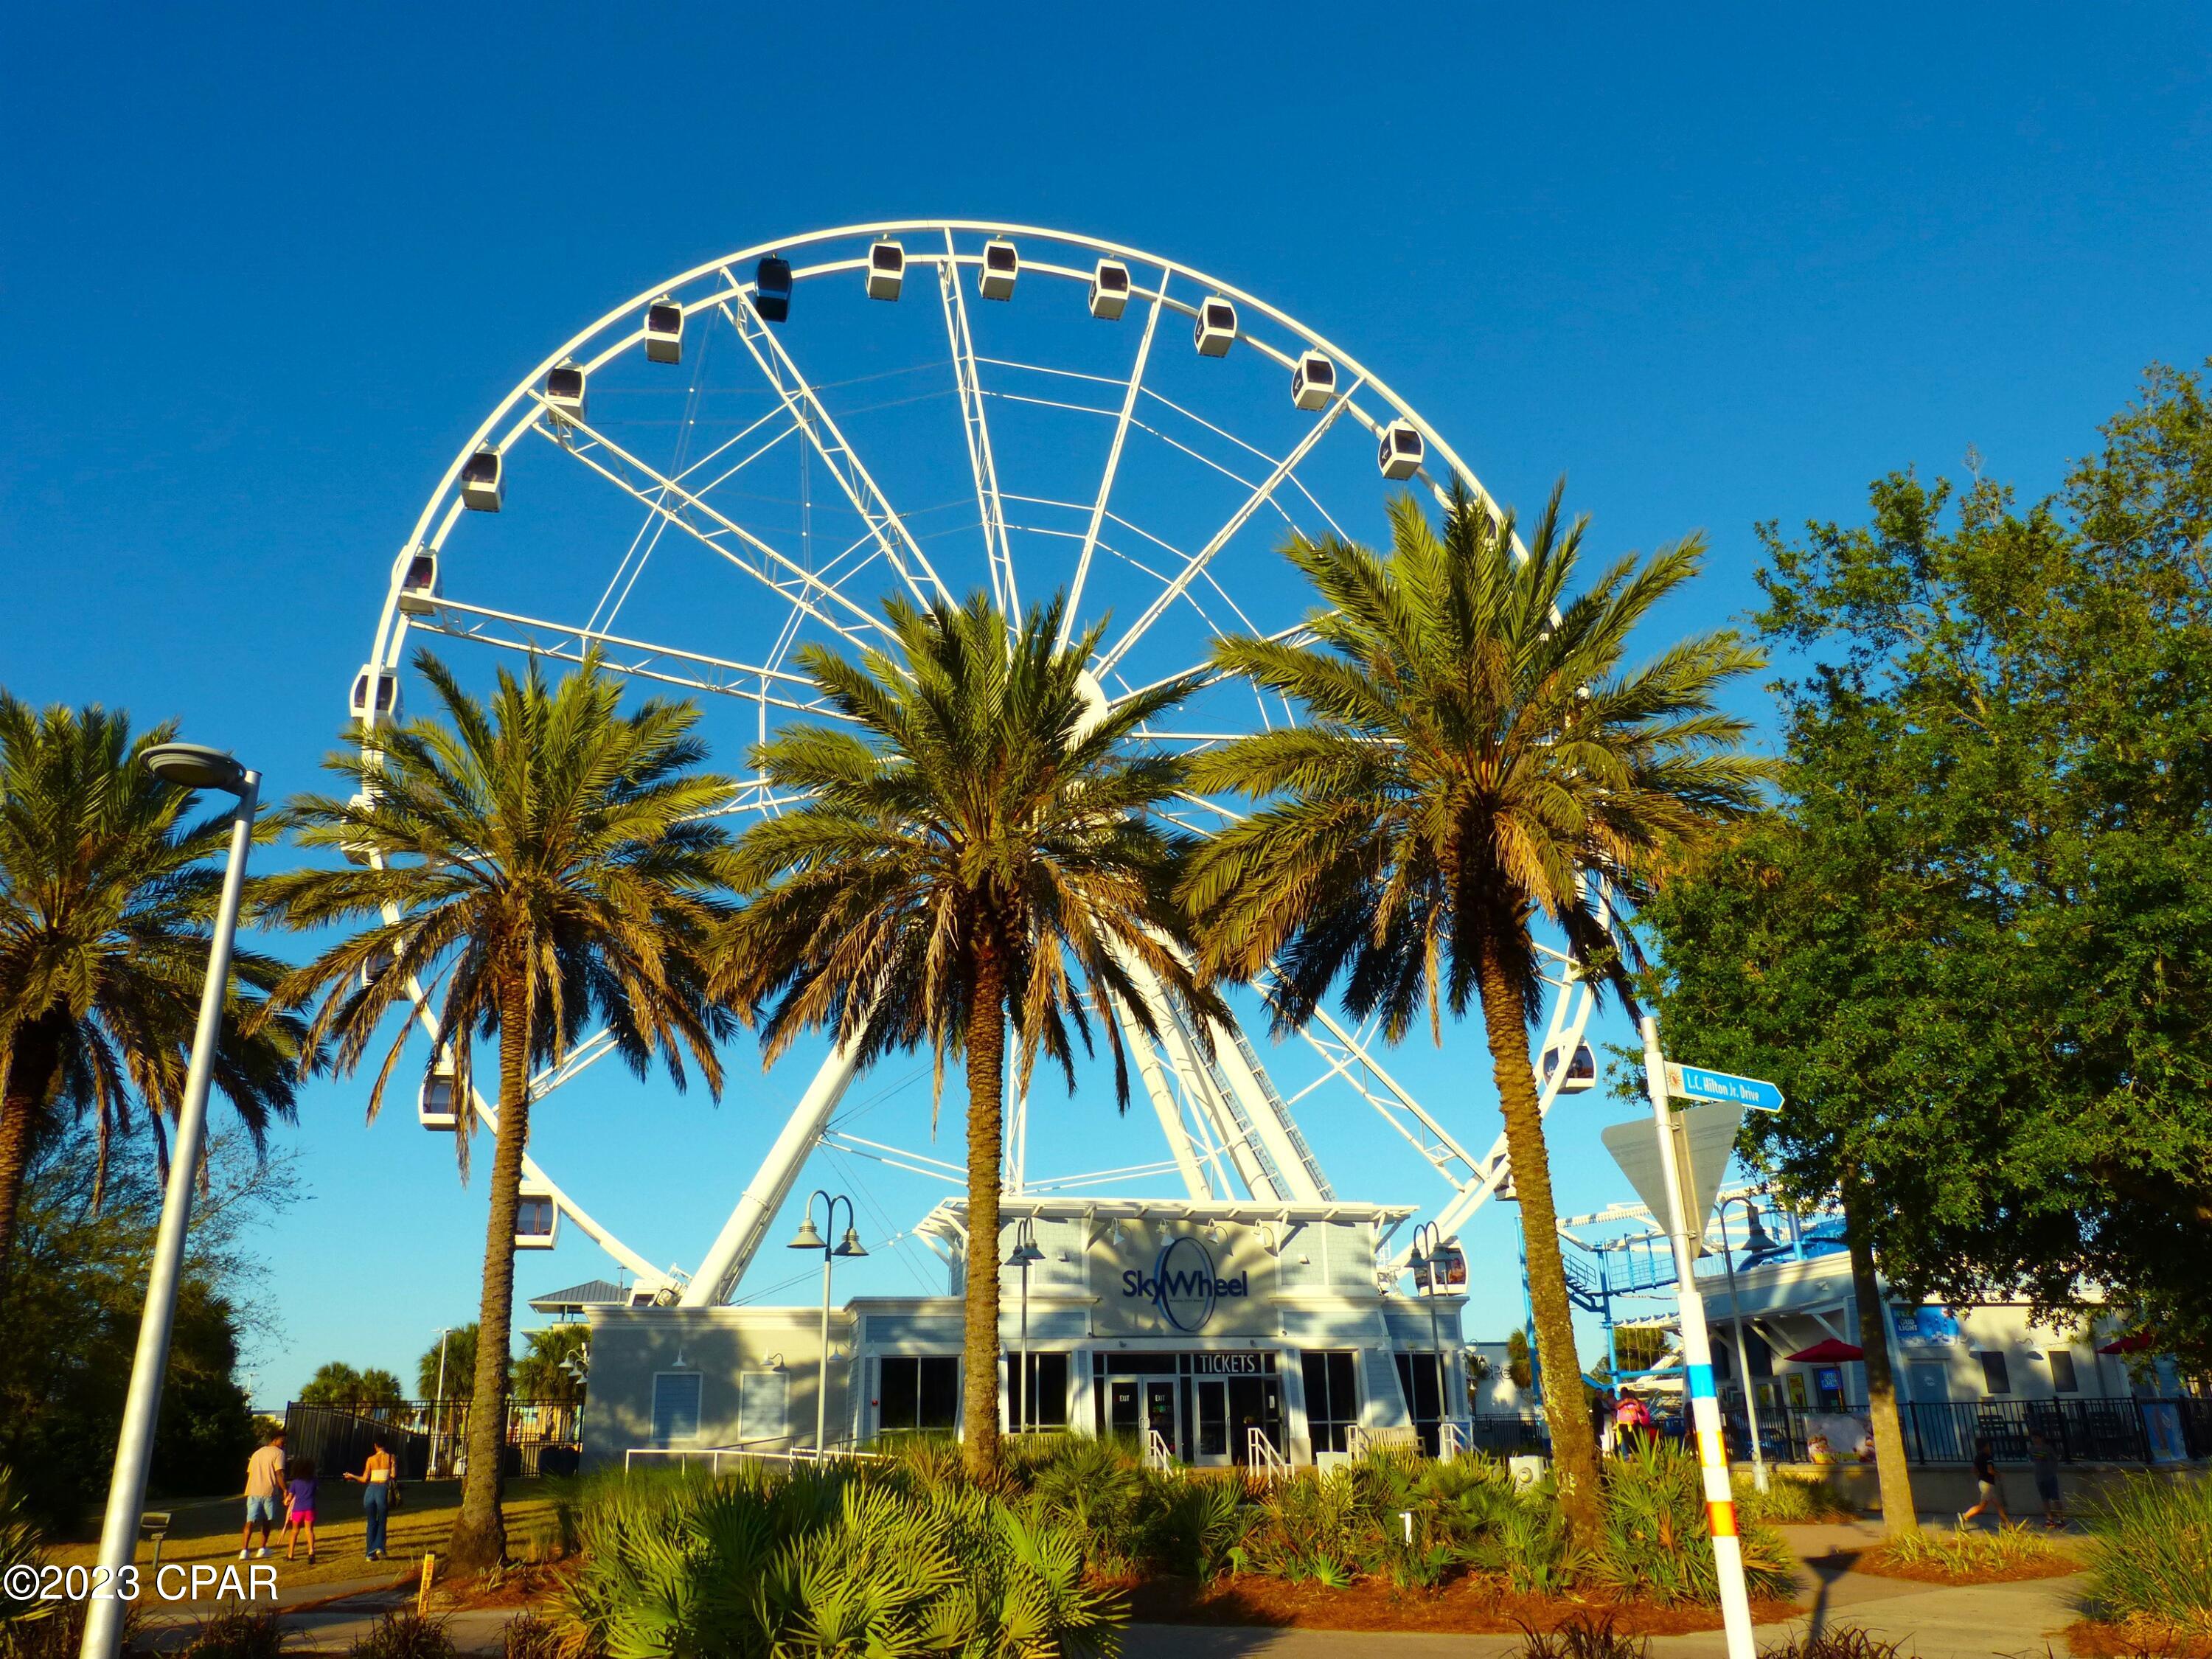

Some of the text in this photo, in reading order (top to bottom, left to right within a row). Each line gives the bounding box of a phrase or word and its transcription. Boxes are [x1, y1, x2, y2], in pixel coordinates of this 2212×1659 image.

[1686, 1073, 1759, 1102] L.C. Hilton Jr. Drive
[1122, 1270, 1248, 1305] SkyWheel
[1200, 1354, 1256, 1373] TICKETS
